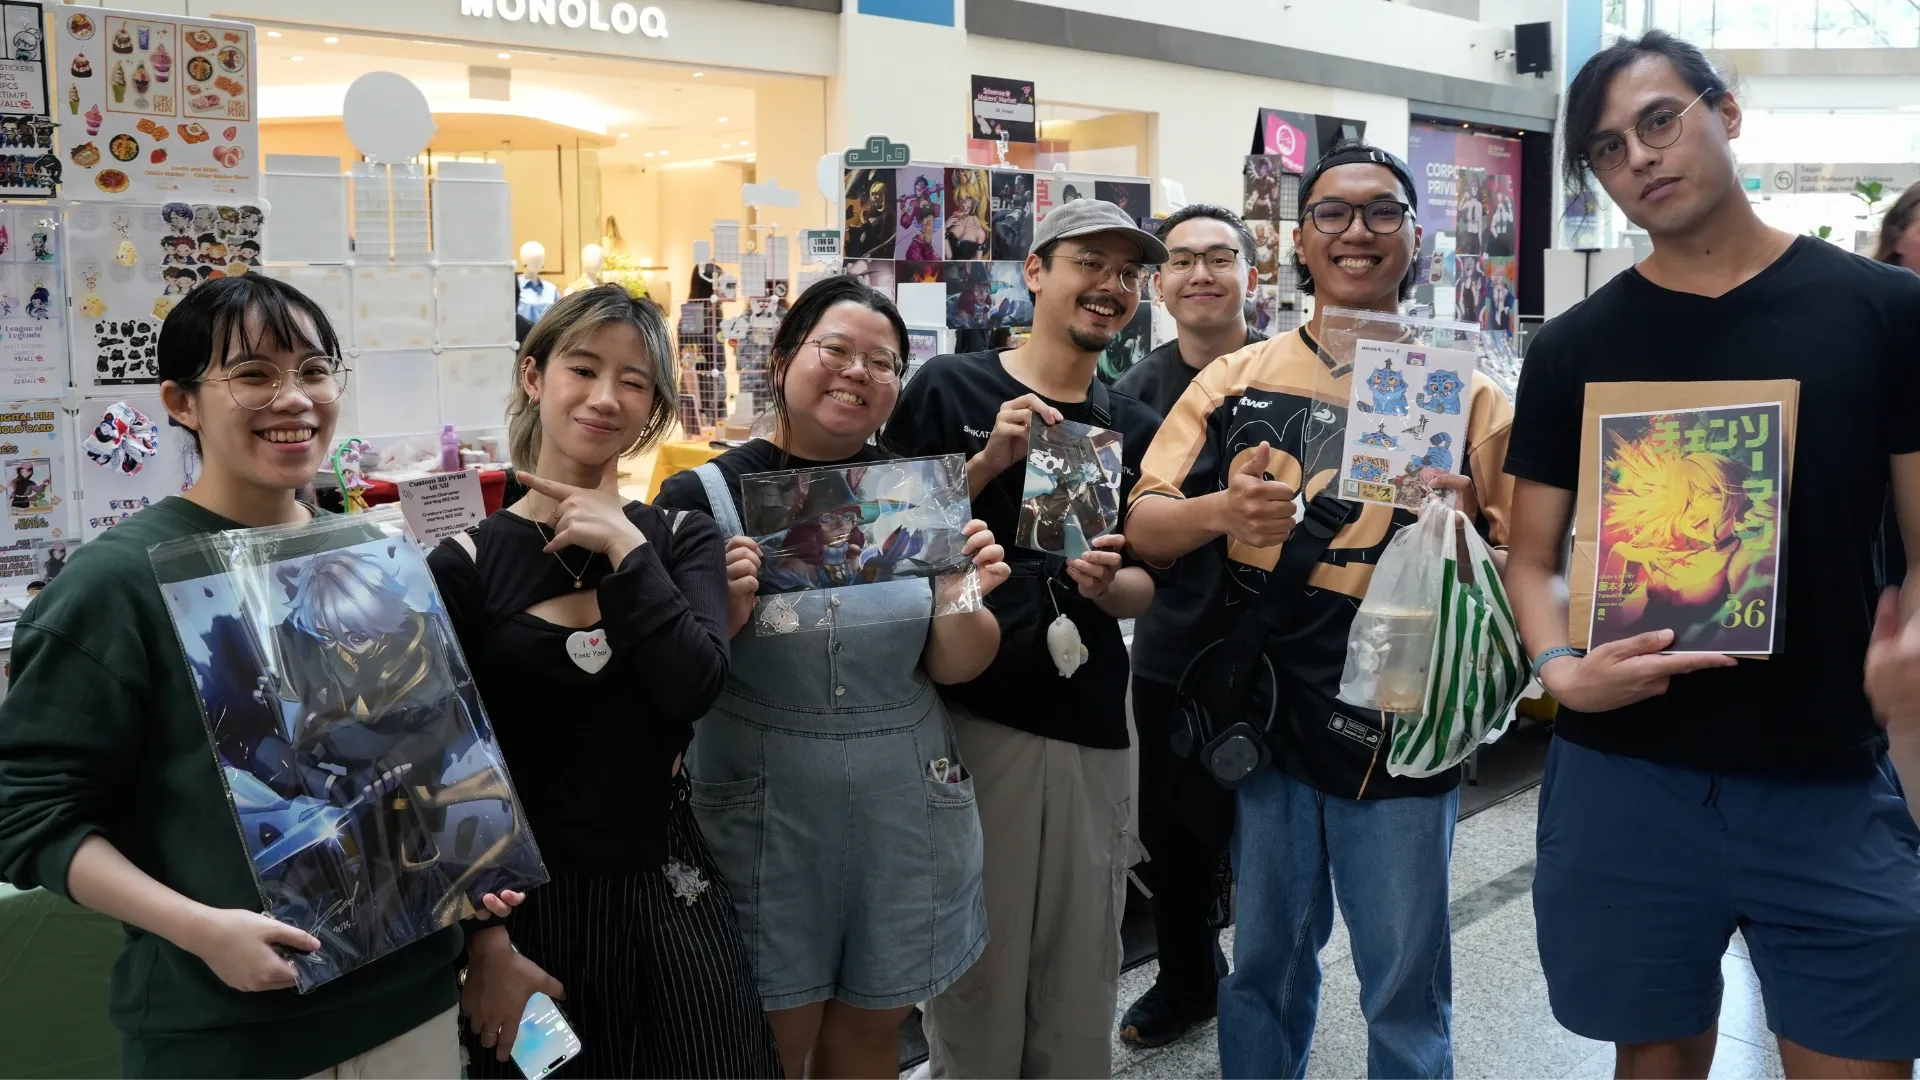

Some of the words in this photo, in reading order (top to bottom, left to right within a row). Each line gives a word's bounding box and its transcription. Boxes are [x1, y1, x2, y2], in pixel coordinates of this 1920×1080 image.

[461, 0, 668, 38] MONOLOQ
[0, 64, 35, 73] STICKERS
[0, 92, 27, 100] T(M/F)
[1428, 180, 1459, 197] PRIVIL
[34, 412, 55, 421] FILE
[25, 424, 55, 433] CARD
[1352, 455, 1364, 466] MY
[408, 478, 437, 488] Custom
[448, 473, 467, 481] Print
[1720, 598, 1766, 629] 36
